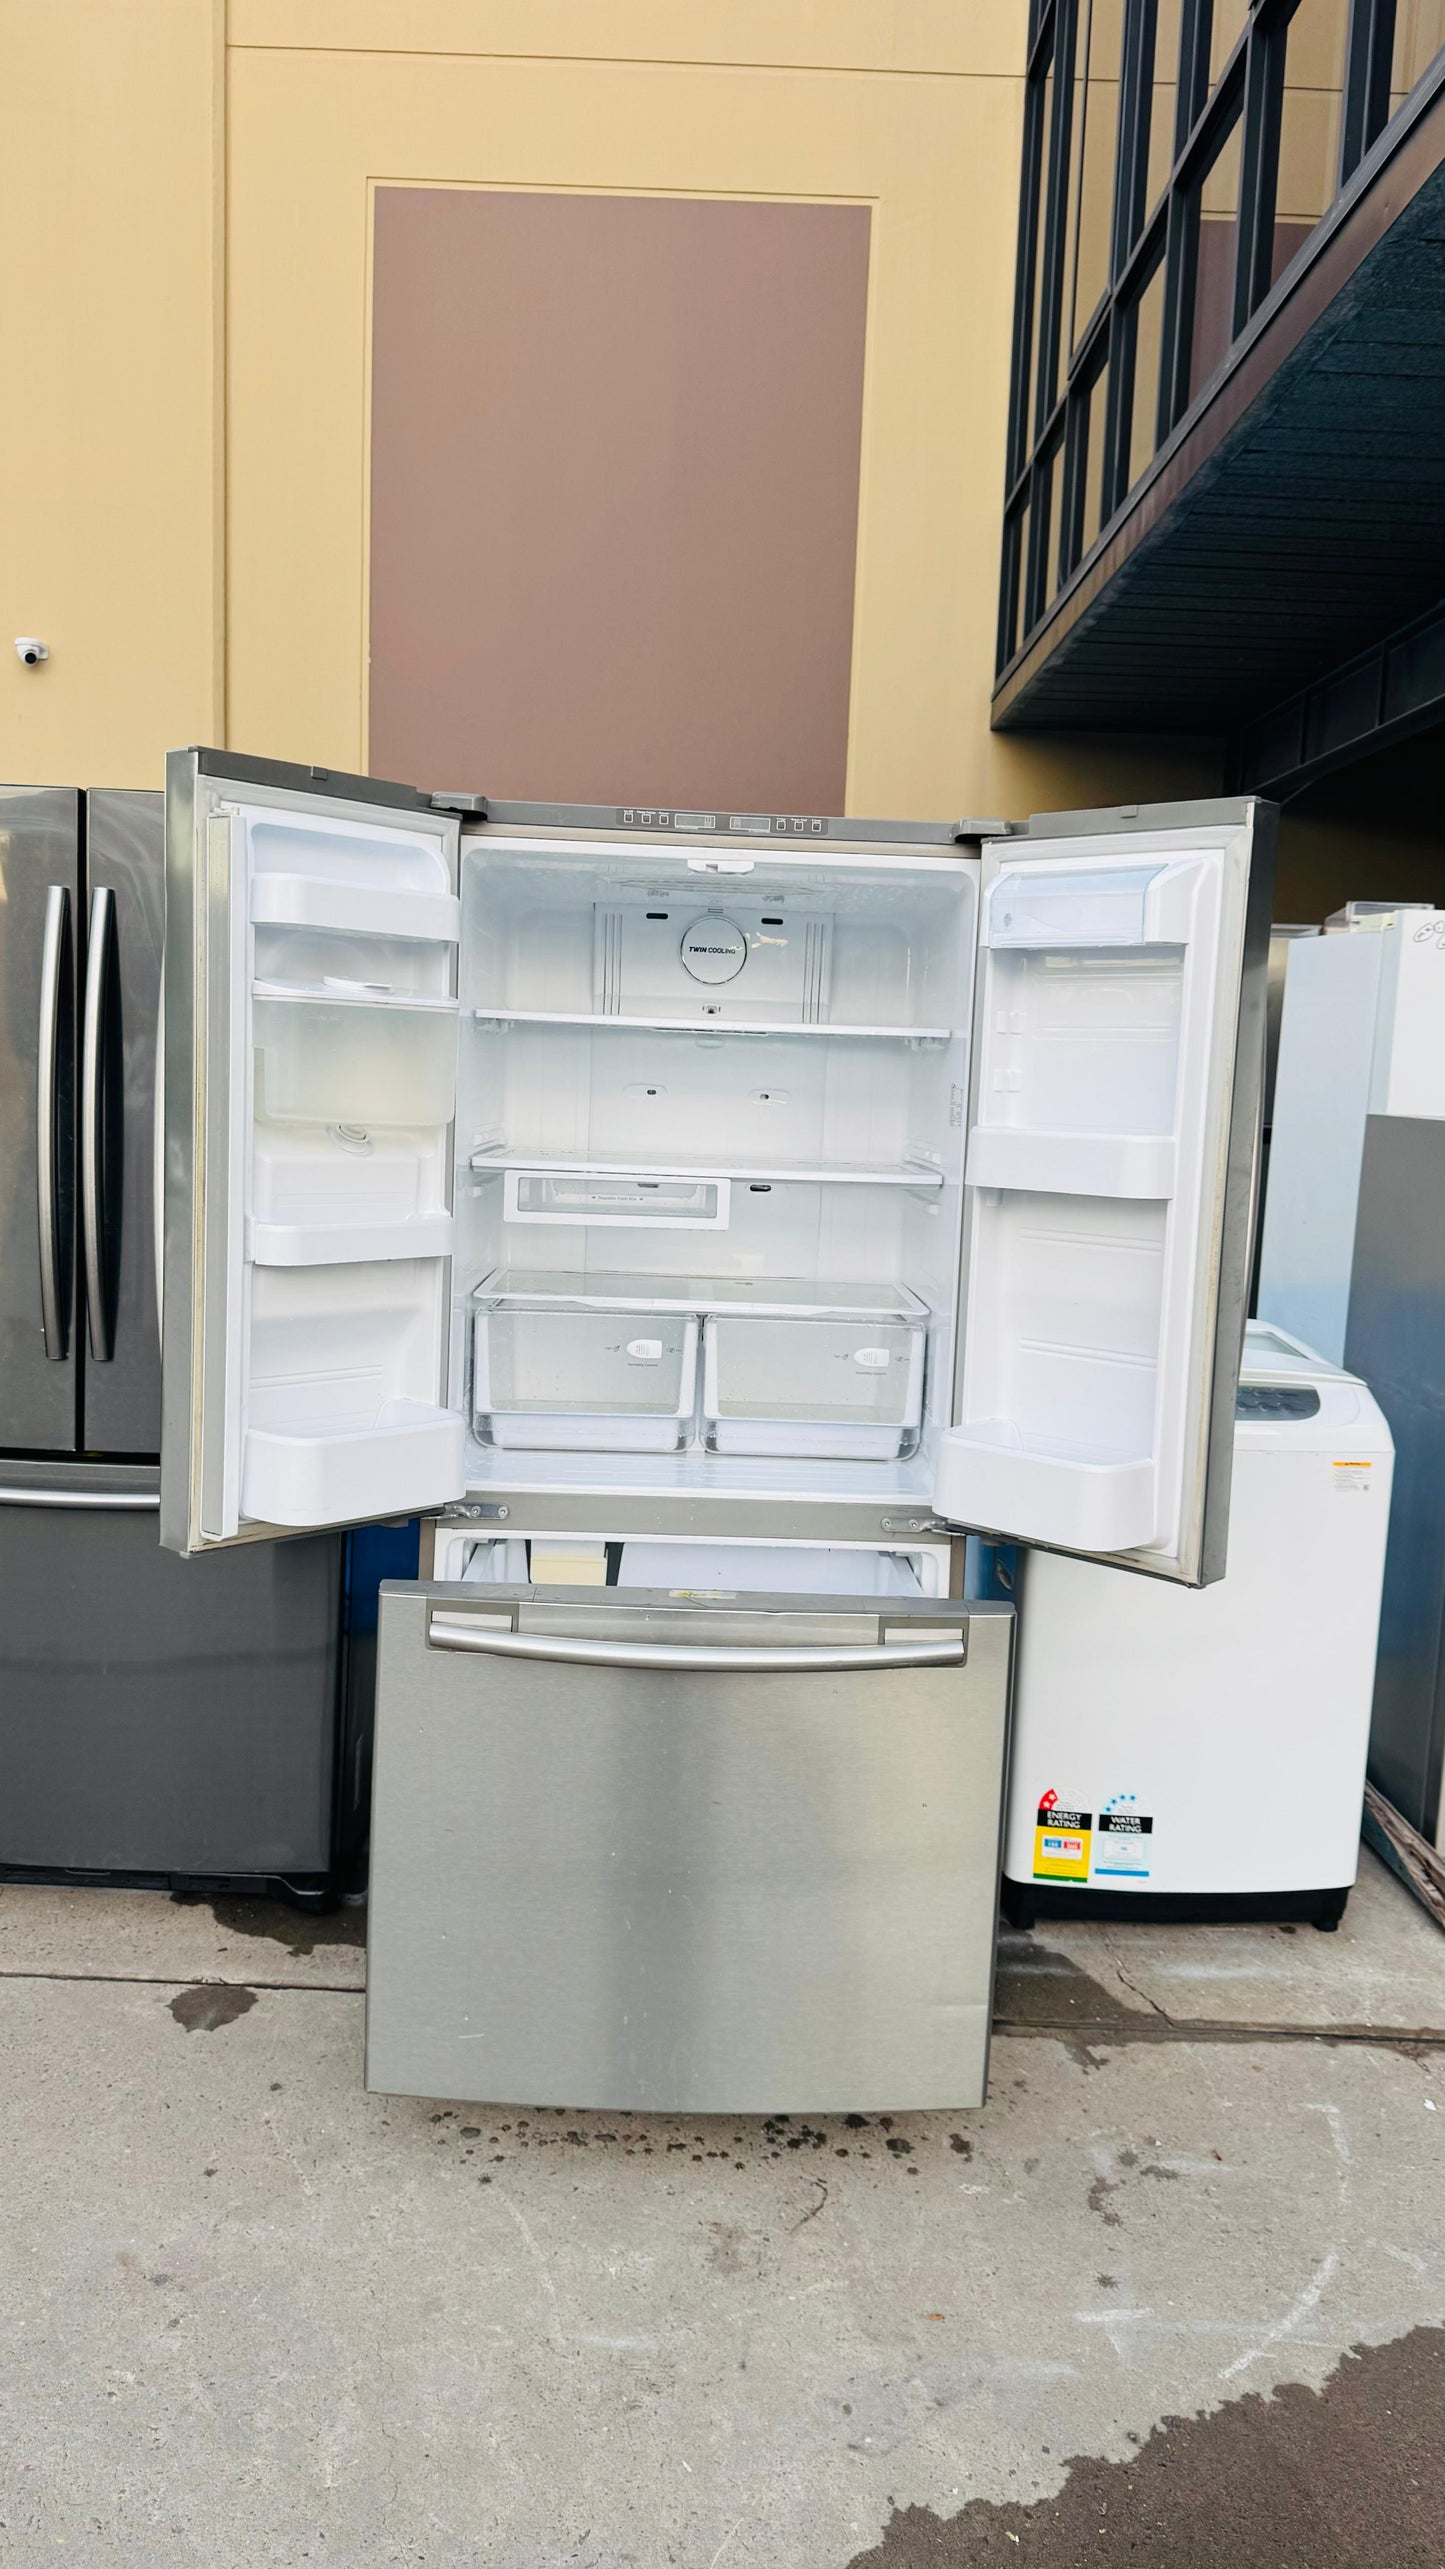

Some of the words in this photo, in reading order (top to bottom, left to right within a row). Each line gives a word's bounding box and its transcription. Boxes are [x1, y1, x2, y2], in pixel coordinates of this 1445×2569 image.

[1047, 1811, 1081, 1821] ENERGY
[1047, 1819, 1080, 1828] RATING
[1110, 1816, 1141, 1826] WATER
[1109, 1823, 1142, 1832] RATING
